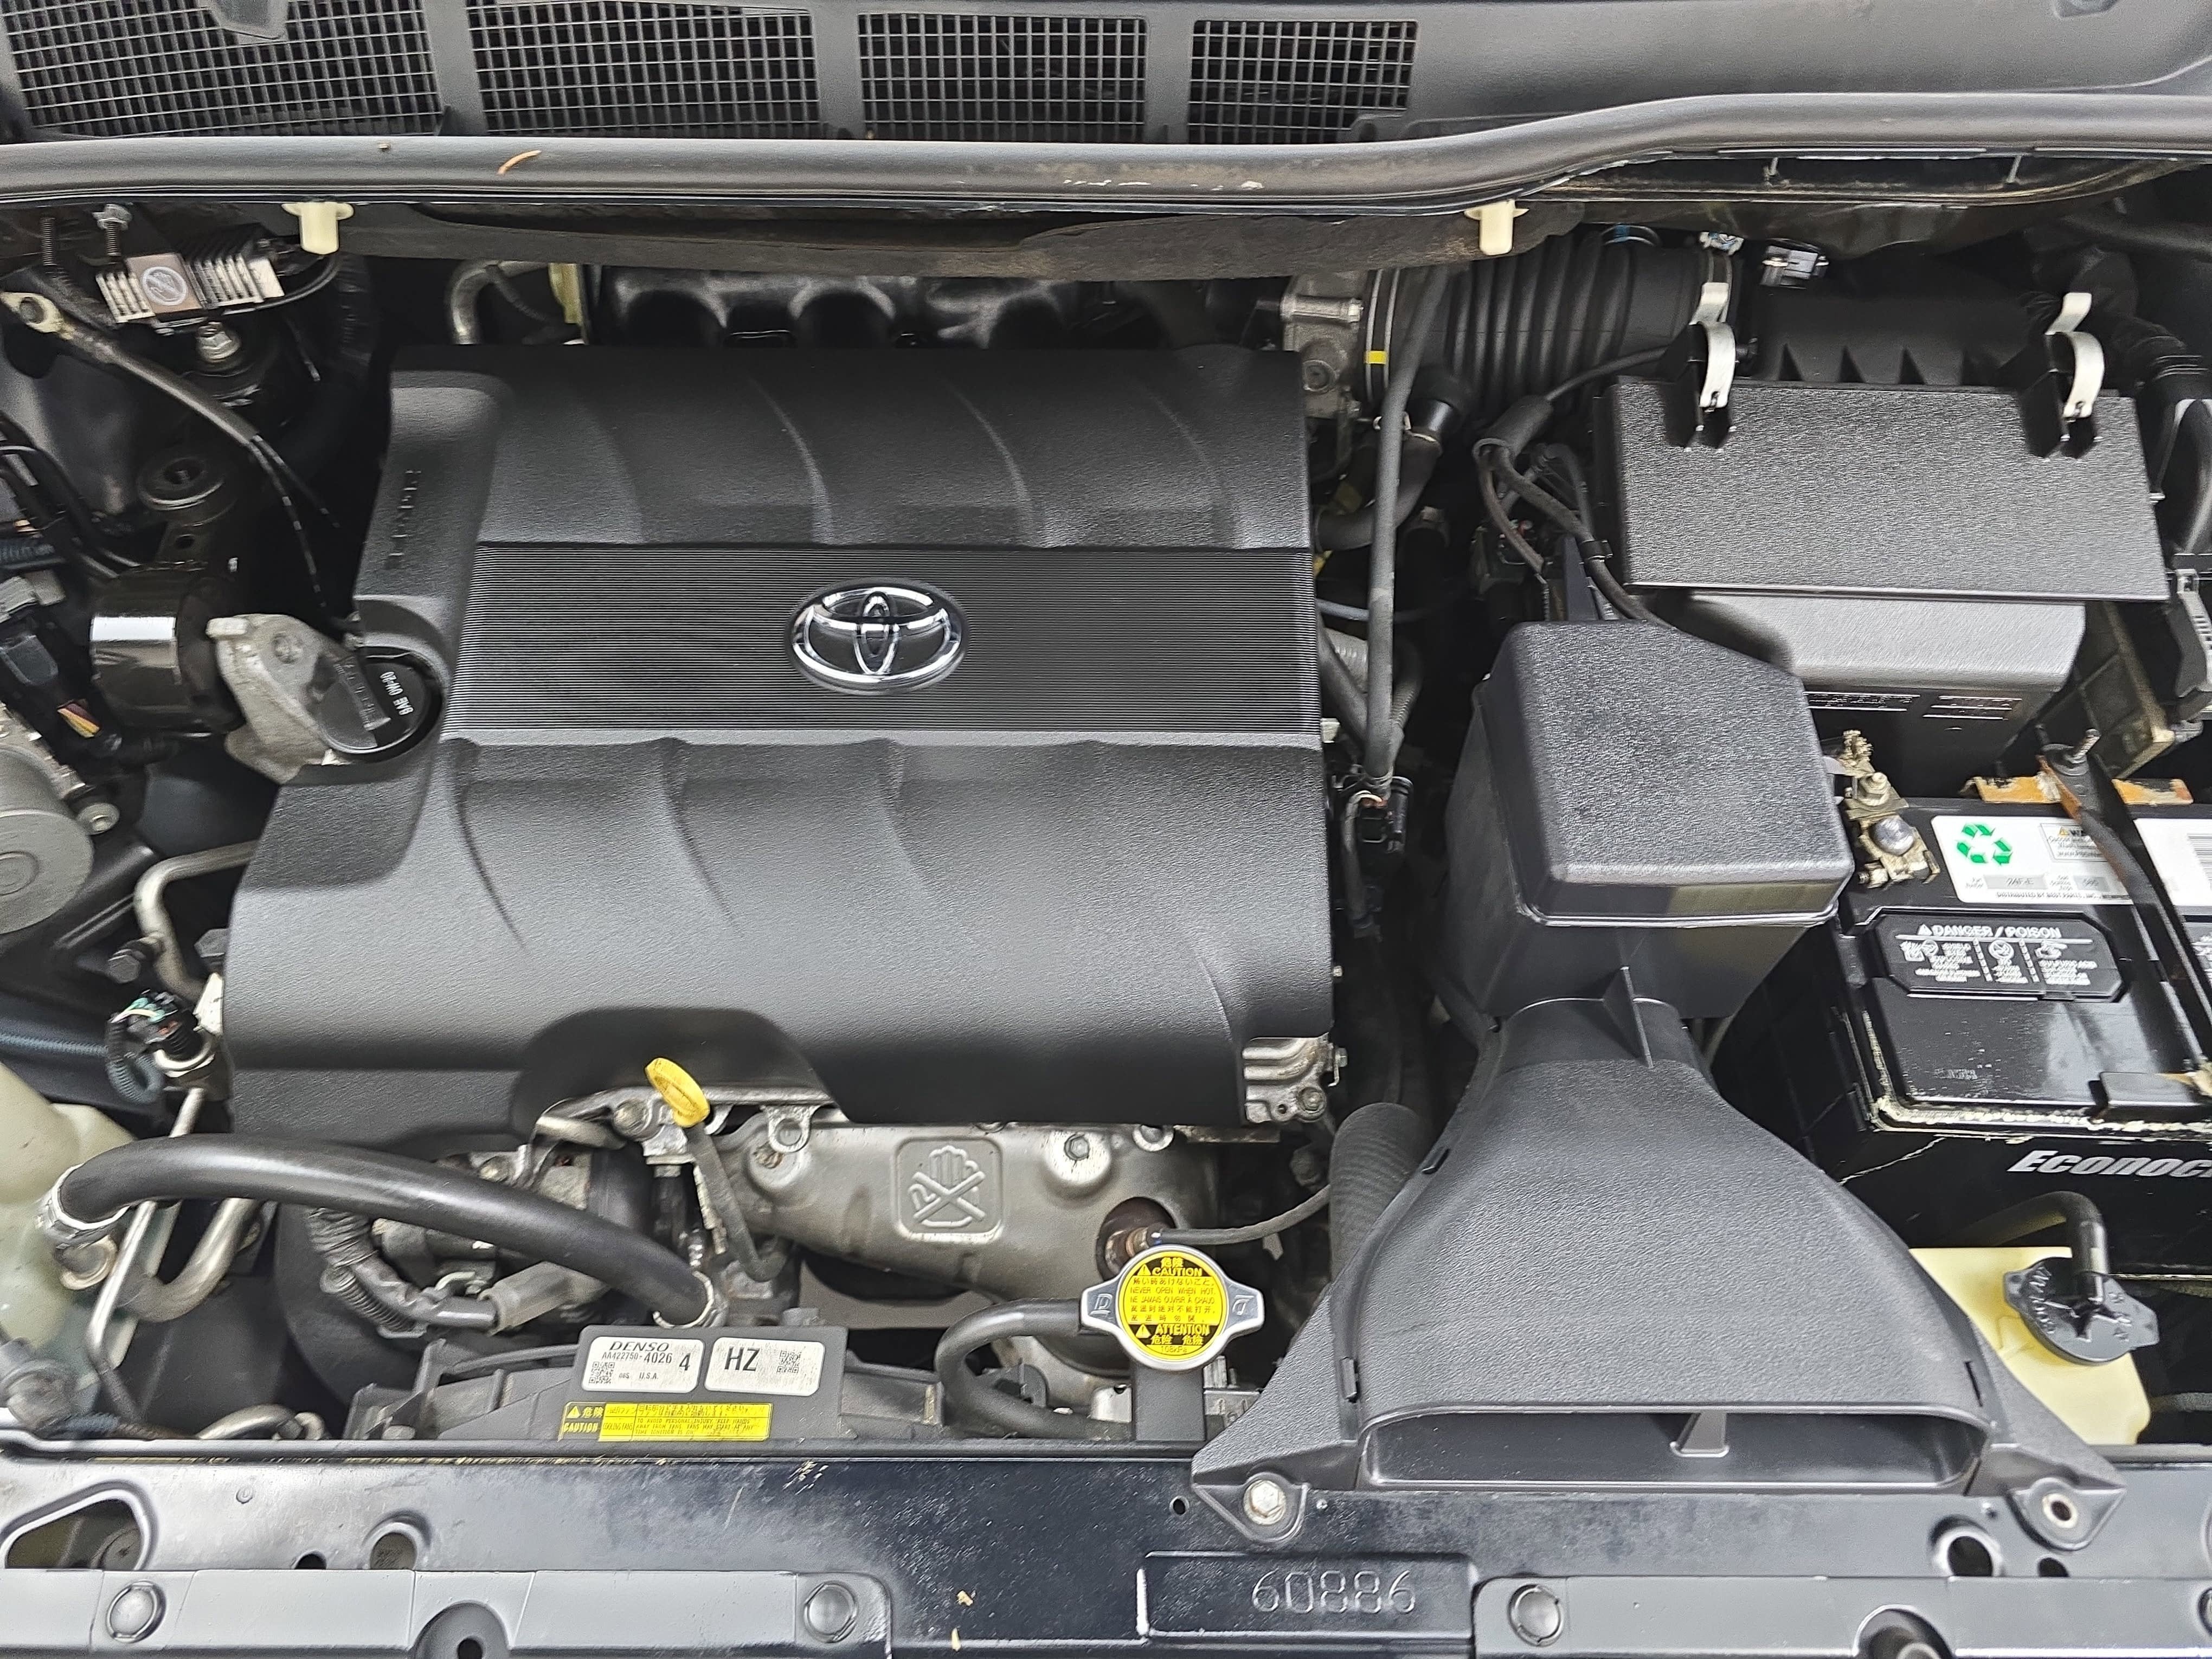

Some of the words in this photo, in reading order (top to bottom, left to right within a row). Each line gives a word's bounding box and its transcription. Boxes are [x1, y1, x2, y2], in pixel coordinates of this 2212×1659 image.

[1931, 924, 1994, 937] DANGER
[2005, 926, 2062, 938] POISON
[2007, 1150, 2212, 1178] Econoc
[1152, 1267, 1203, 1277] CAUTION
[1155, 1323, 1210, 1336] ATTENTION
[609, 1341, 670, 1352] DENSO
[679, 1353, 691, 1371] 4
[724, 1346, 761, 1372] HZ
[563, 1422, 599, 1433] CAUTION
[1252, 1570, 1416, 1613] 60886
